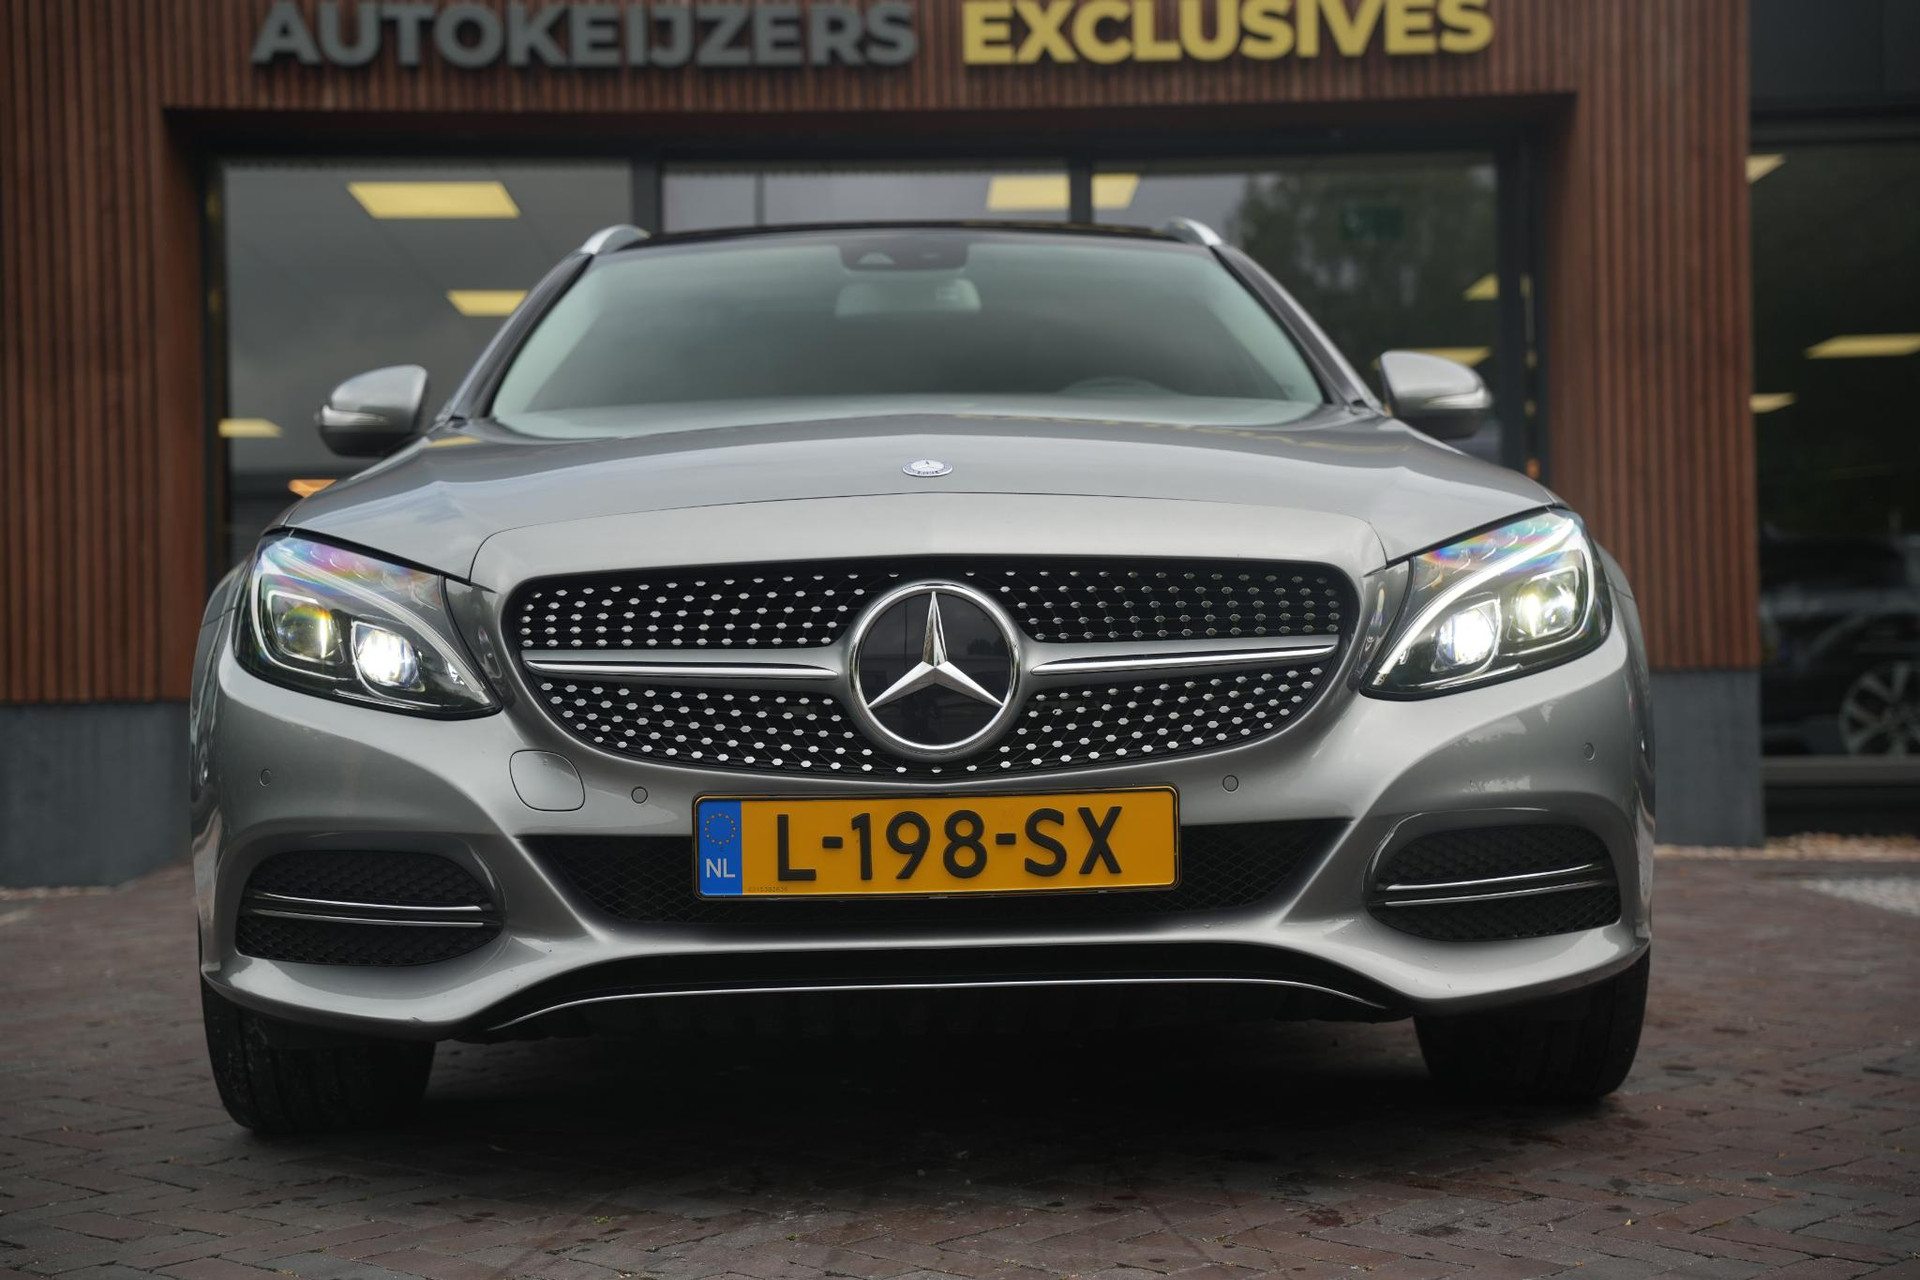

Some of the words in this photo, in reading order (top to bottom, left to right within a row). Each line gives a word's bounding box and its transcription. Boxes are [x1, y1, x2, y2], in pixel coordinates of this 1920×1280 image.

[252, 0, 919, 67] AUTOKEIJZERS
[963, 0, 1495, 64] EXCLUSIVES
[706, 858, 736, 878] NL
[776, 806, 1123, 881] L-198-SX
